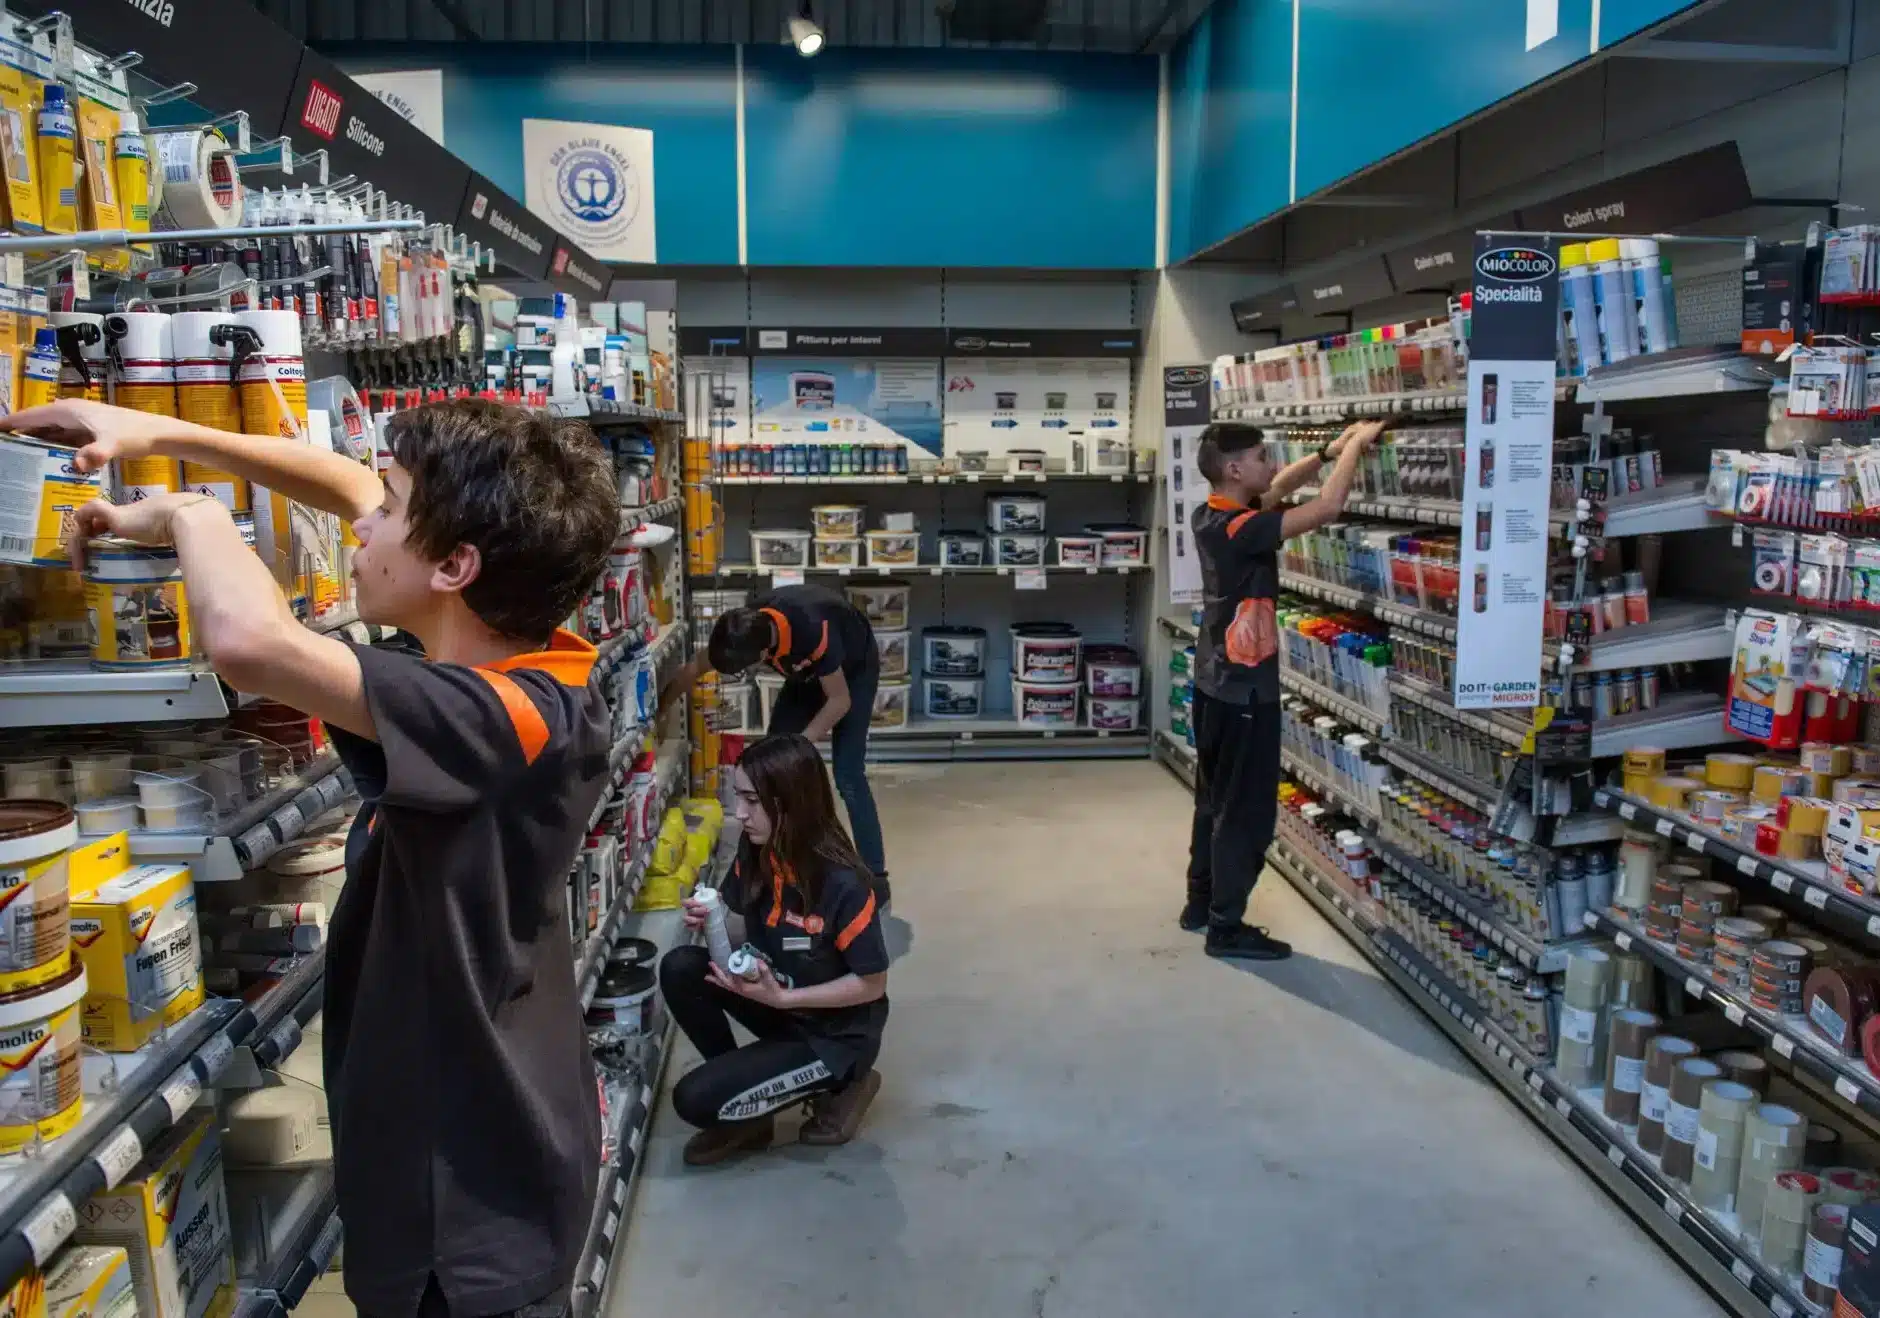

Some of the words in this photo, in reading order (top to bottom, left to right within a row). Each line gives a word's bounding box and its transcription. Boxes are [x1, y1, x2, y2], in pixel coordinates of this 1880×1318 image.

[305, 85, 341, 136] LUGATO
[346, 115, 385, 157] Silicone
[1564, 207, 1595, 228] Colori
[1595, 200, 1625, 222] spray
[1482, 258, 1550, 272] MIOCOLOR
[1475, 285, 1543, 305] Specialità
[1459, 683, 1475, 693] DO
[1476, 683, 1487, 692] IT
[1493, 682, 1537, 692] GARDEN
[1493, 693, 1536, 702] MIGROS
[136, 949, 168, 973] Fugen
[771, 1080, 787, 1094] ON
[792, 1069, 815, 1086] KEEP
[174, 1202, 210, 1250] Aussen
